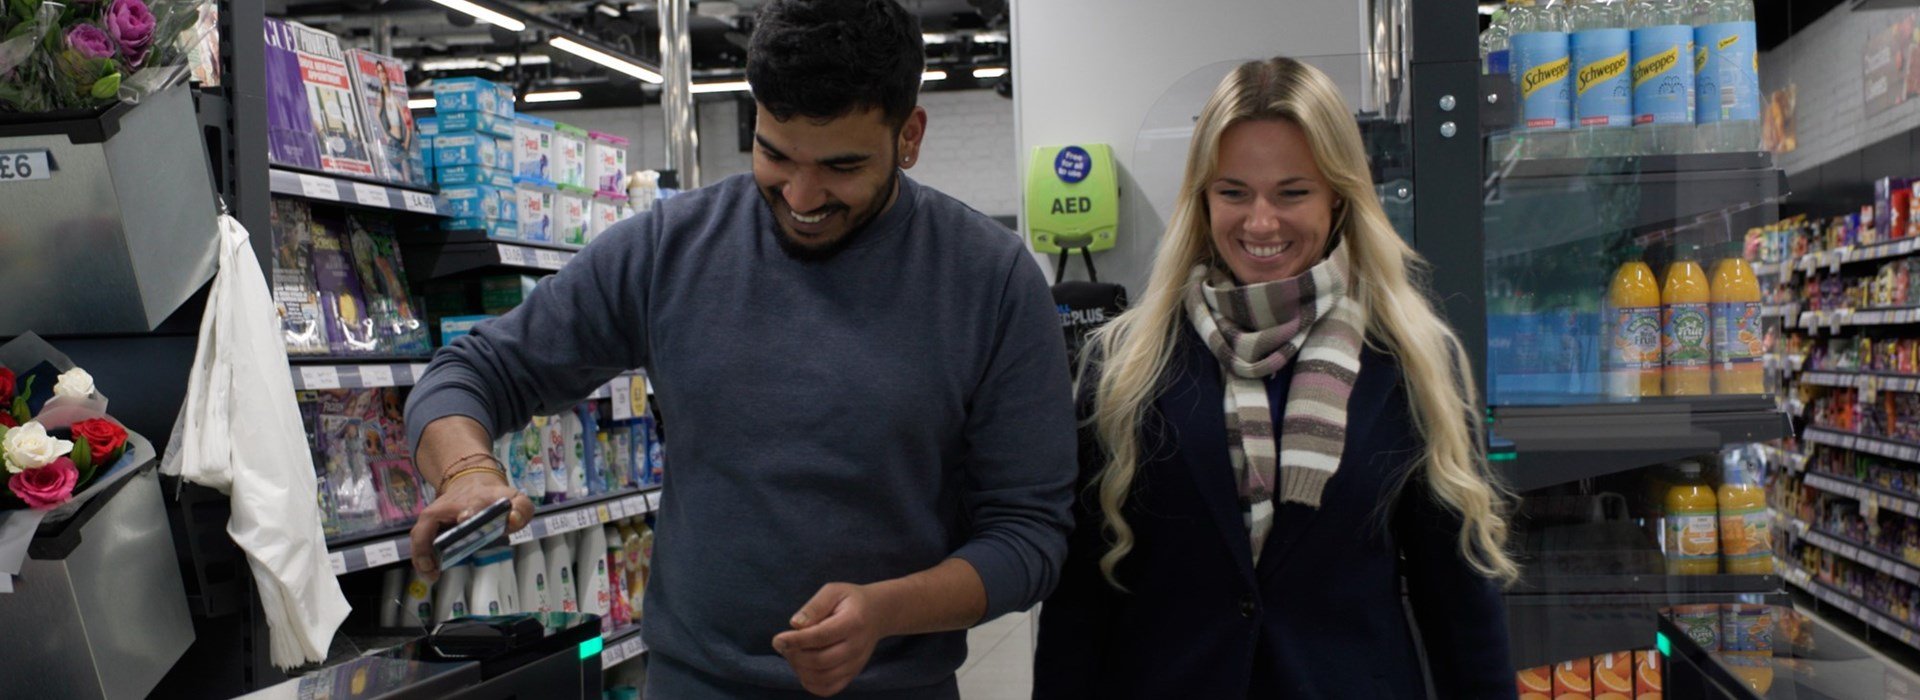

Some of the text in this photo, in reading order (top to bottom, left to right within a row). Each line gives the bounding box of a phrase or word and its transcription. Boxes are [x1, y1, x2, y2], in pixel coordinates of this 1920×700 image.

[264, 20, 297, 52] GUE
[1525, 61, 1569, 92] Schweppe
[1579, 58, 1627, 91] Schweppes
[0, 154, 32, 178] £6
[1061, 159, 1084, 170] for all
[1065, 151, 1083, 161] Free
[1067, 170, 1082, 178] use
[1051, 196, 1092, 215] AED
